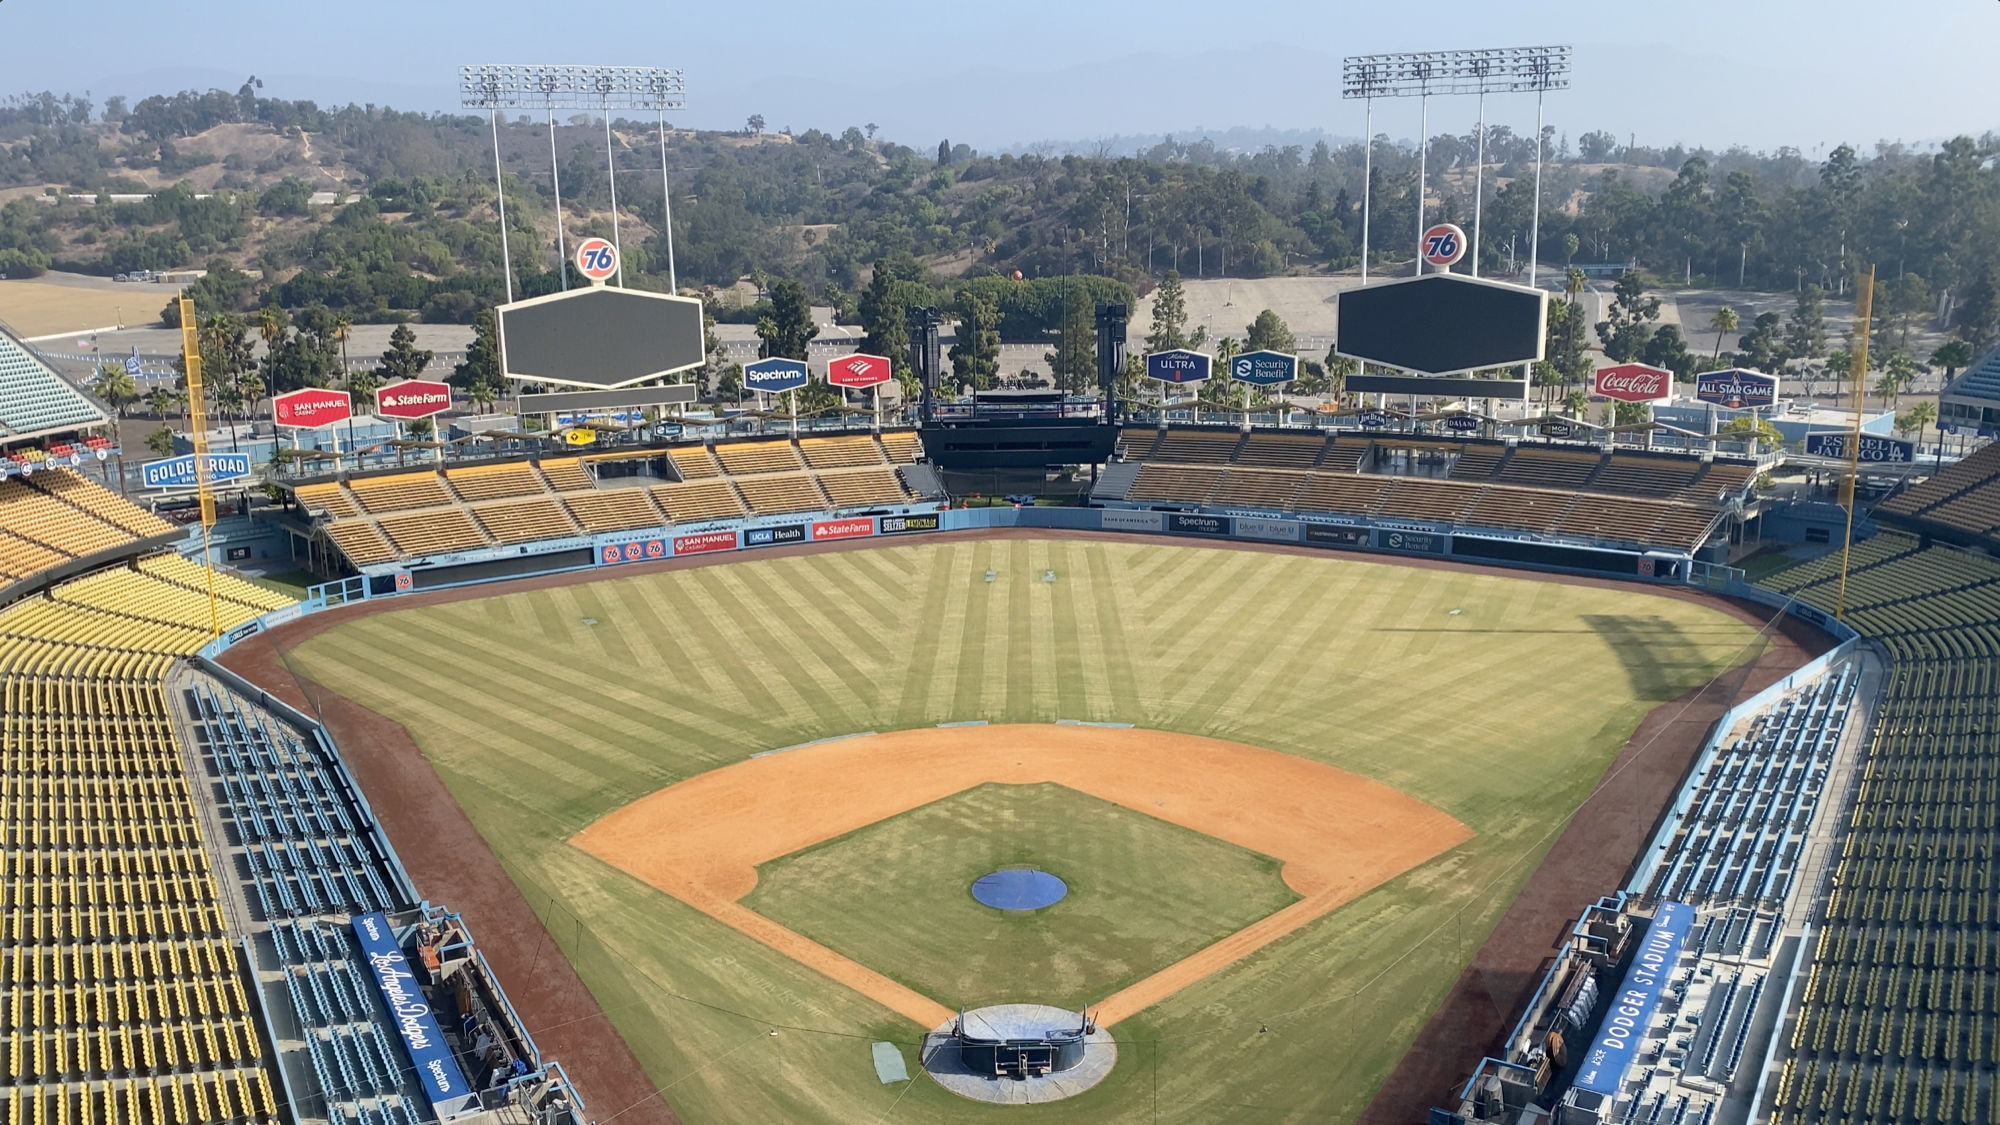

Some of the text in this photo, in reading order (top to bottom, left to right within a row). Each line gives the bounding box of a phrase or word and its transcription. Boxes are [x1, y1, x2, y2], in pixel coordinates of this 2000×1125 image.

[1426, 232, 1457, 258] 76
[583, 246, 614, 271] 76
[1160, 360, 1196, 370] ULTRA
[1255, 360, 1289, 370] Security
[750, 369, 799, 383] Spectrum
[1255, 369, 1285, 378] Benefit
[1601, 372, 1664, 394] Coca-Cola
[1700, 383, 1773, 397] ALL STAR GAME
[294, 400, 347, 411] SAN MANUEL
[209, 458, 245, 473] ROAD
[1178, 516, 1217, 527] Spectrum
[1239, 522, 1257, 530] blue
[1269, 524, 1287, 532] blue
[684, 534, 734, 546] SAN MANUEL
[752, 529, 801, 541] UCLA Health
[607, 544, 661, 558] 76 76 76
[399, 577, 409, 585] 76
[361, 917, 380, 941] Spectrum
[1602, 930, 1676, 1051] DODGER STADIUM
[370, 951, 433, 1050] Los Angeles Dodgers
[427, 1059, 451, 1093] Spectrum
